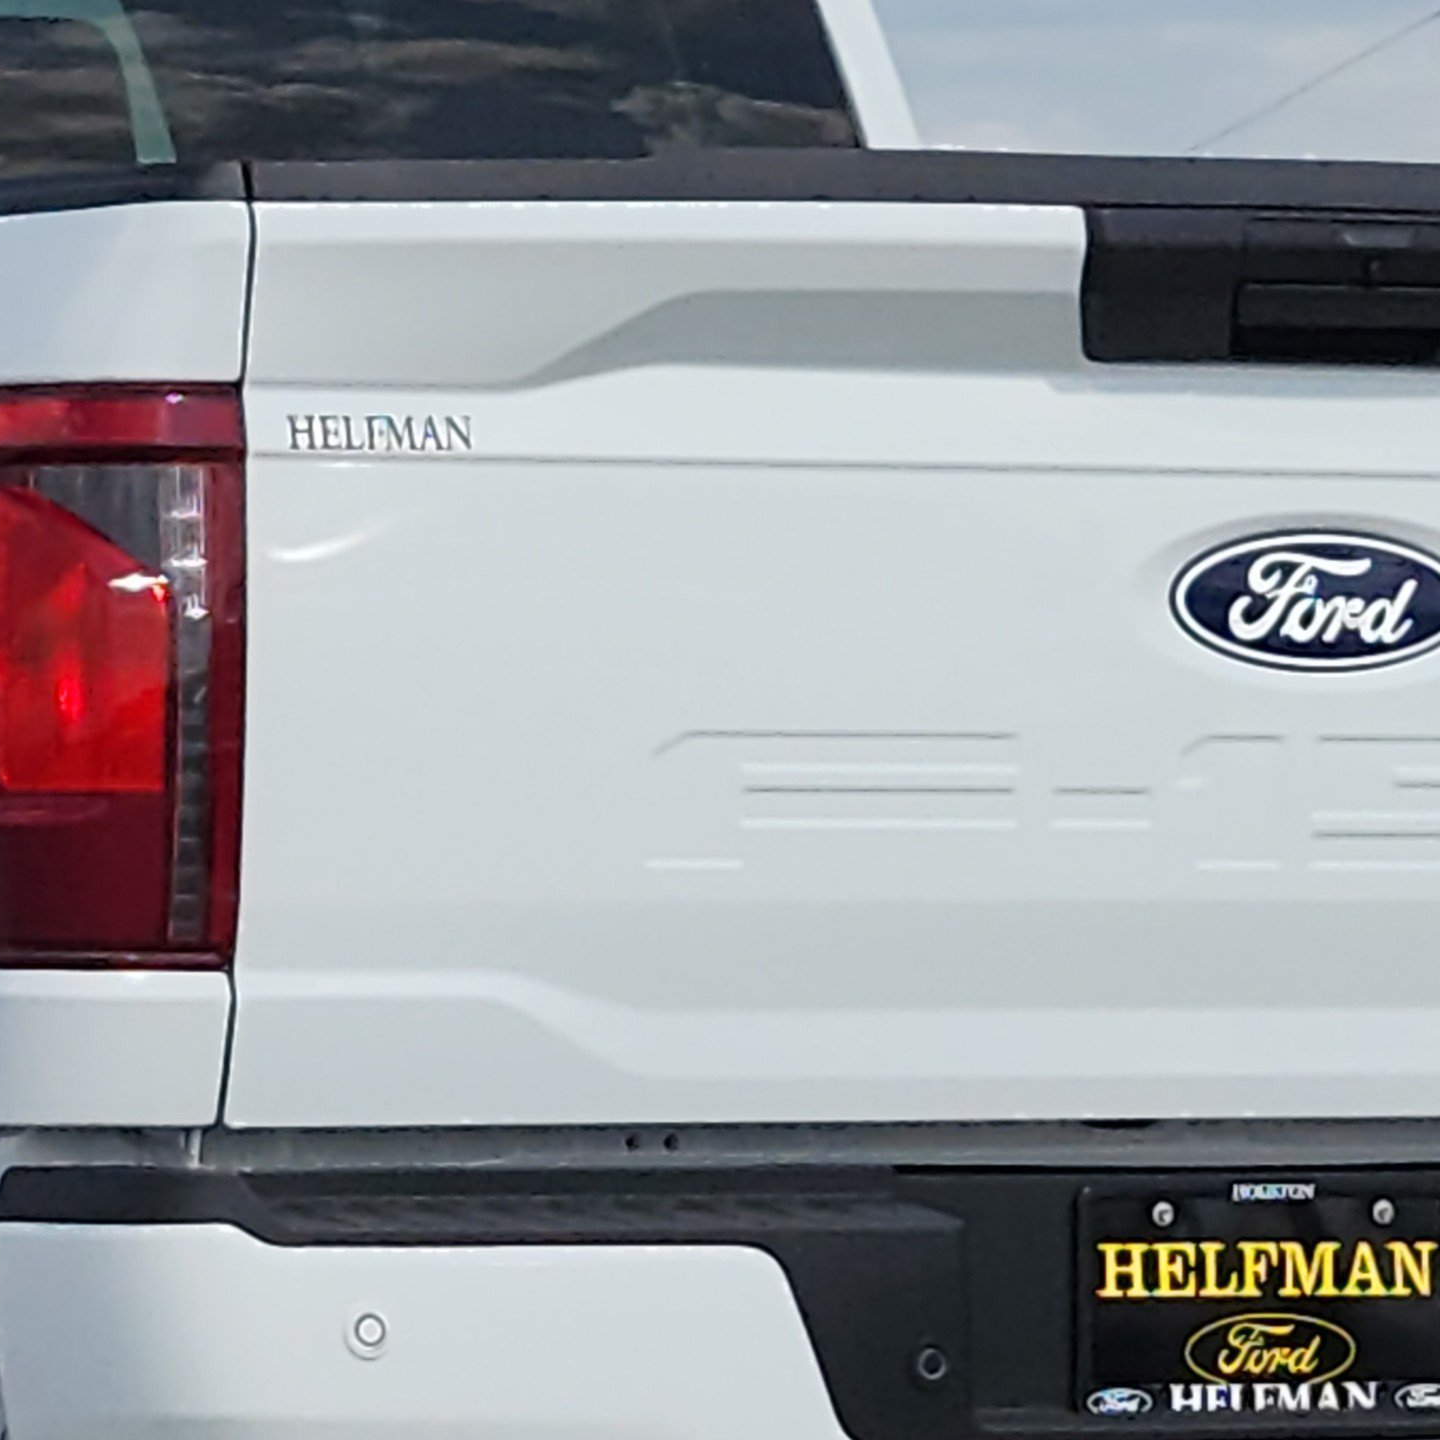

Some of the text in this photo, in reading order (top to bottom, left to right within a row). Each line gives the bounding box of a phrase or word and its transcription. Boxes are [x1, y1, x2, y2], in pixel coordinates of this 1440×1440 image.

[286, 414, 472, 451] HELFMAN
[1228, 551, 1418, 643] Ford
[1096, 1241, 1439, 1297] HELFMAN
[1218, 1323, 1320, 1374] Ford
